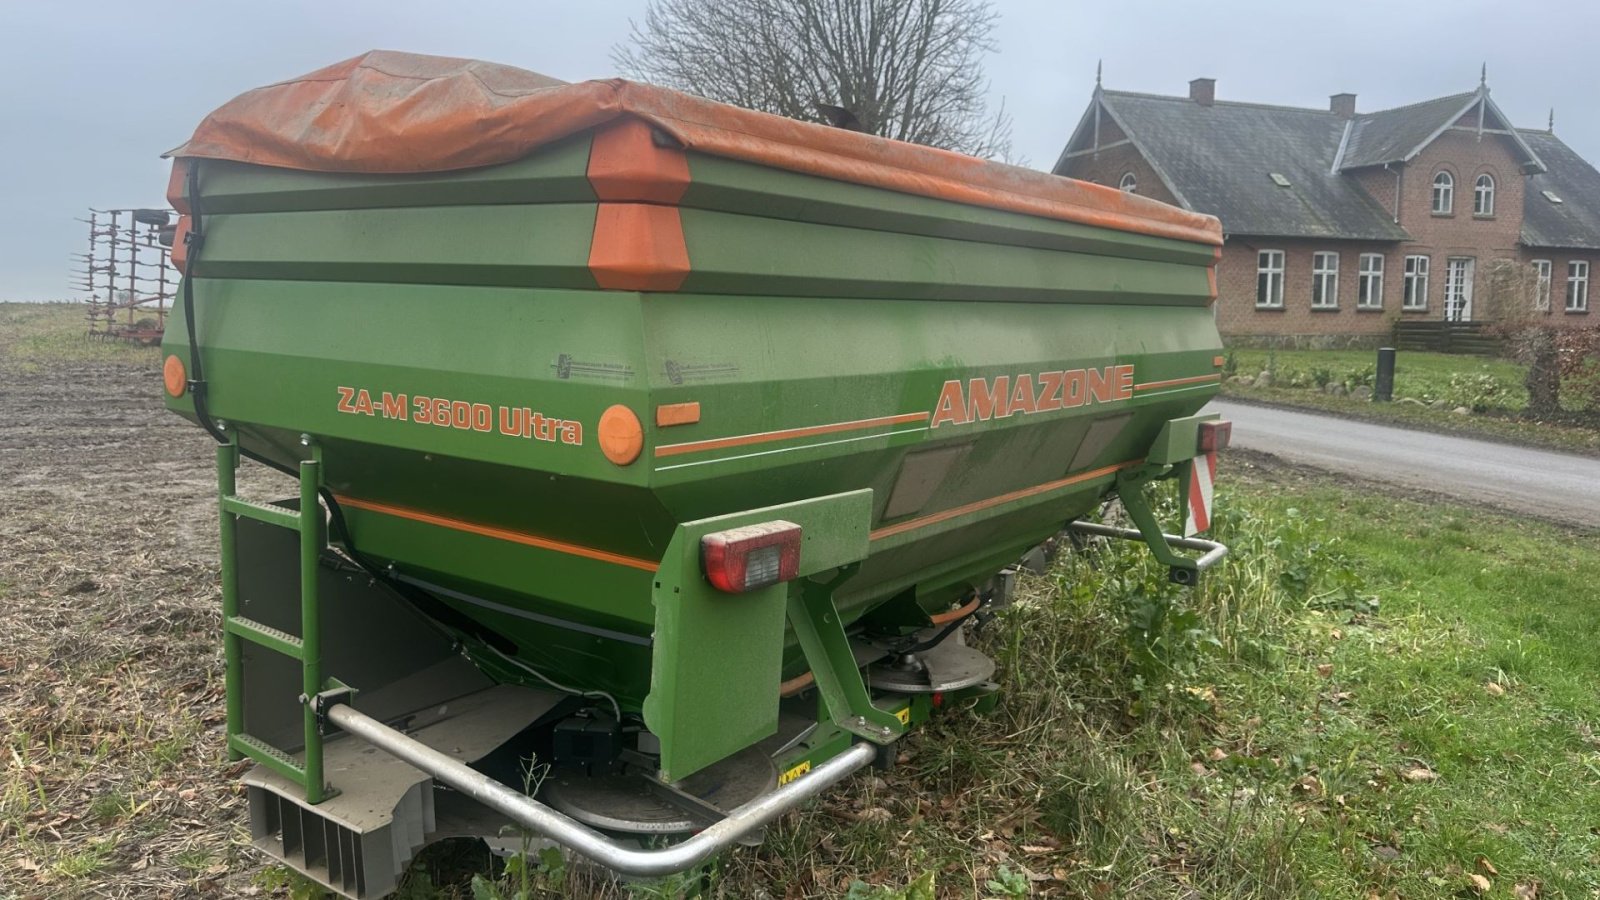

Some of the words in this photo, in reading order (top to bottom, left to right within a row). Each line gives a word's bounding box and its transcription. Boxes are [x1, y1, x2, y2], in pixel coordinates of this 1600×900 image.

[337, 386, 408, 421] ZA-M
[413, 395, 492, 432] 3600
[499, 406, 583, 446] Ultra
[930, 364, 1134, 429] AMAZONE
